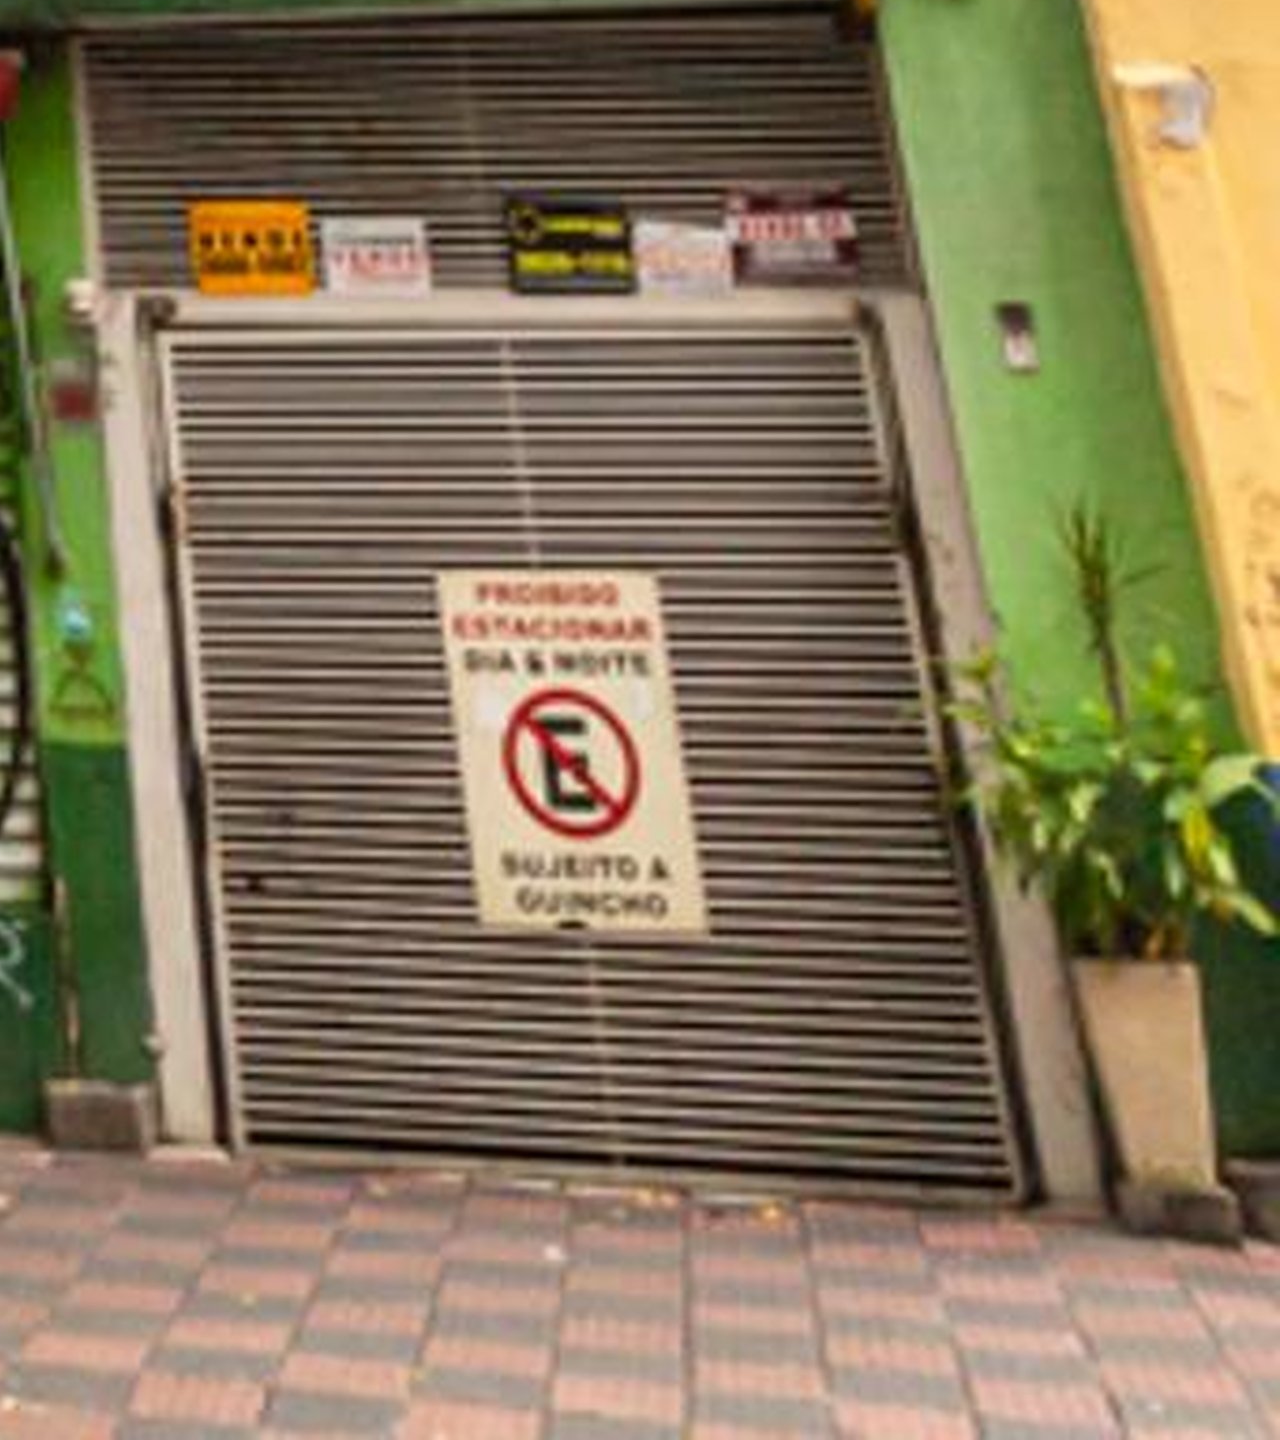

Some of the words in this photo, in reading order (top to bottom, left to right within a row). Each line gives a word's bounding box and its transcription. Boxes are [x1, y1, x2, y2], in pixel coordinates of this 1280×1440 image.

[475, 582, 620, 607] PROIBIDO
[451, 614, 653, 642] ESTACIONAR
[463, 648, 516, 674] DIA
[552, 650, 651, 677] NOITE
[500, 851, 640, 880] SUJEITO
[648, 854, 672, 881] A
[515, 885, 670, 919] GUINCHO
